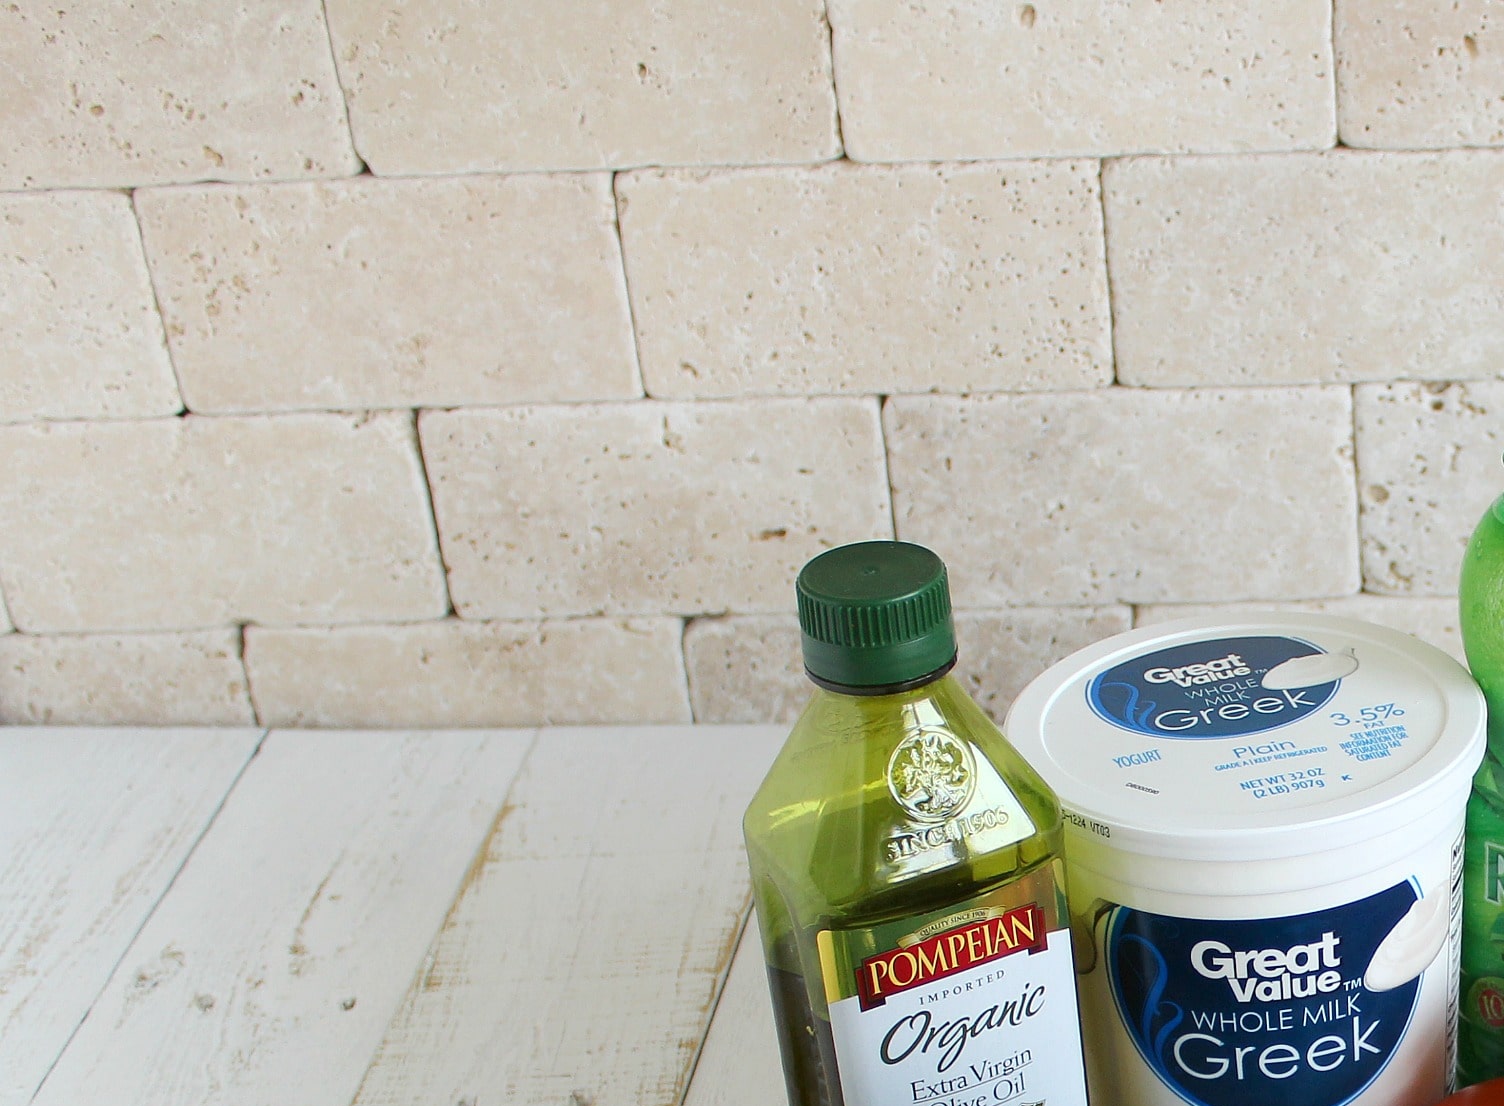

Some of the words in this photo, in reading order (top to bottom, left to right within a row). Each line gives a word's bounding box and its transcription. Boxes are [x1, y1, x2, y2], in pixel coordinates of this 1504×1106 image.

[1143, 653, 1247, 684] Great
[1175, 667, 1252, 688] Value
[1184, 678, 1260, 700] WHOLE
[1204, 690, 1251, 708] MILK
[1155, 687, 1316, 731] Greek
[1329, 703, 1405, 727] 3.5%
[1232, 740, 1296, 759] Plain
[1339, 735, 1392, 750] INFORMATION
[1112, 749, 1162, 769] YOGURT
[1214, 761, 1242, 772] GRADE
[1254, 755, 1273, 764] KEEP
[1274, 746, 1328, 760] REFRIGERATED
[1356, 750, 1391, 762] CONTENT
[1240, 777, 1264, 790] NET
[1264, 774, 1286, 785] WT
[1289, 771, 1306, 781] 32
[1307, 767, 1326, 778] OZ
[1252, 788, 1267, 799] (2
[1268, 784, 1290, 796] LB)
[1291, 778, 1325, 791] 907g
[920, 918, 949, 936] QUALITY
[949, 912, 970, 925] SINCE
[867, 909, 1035, 995] POMPEIAN
[1190, 931, 1342, 980] Great
[919, 969, 1005, 1006] IMPORTED
[1227, 969, 1342, 1003] Value
[1190, 1008, 1294, 1033] WHOLE
[1302, 992, 1361, 1028] MILK
[880, 982, 1046, 1072] Organic
[1173, 1015, 1382, 1080] Greek
[910, 1074, 968, 1101] Extra
[971, 1048, 1032, 1081] Virgin
[993, 1073, 1026, 1101] Oil
